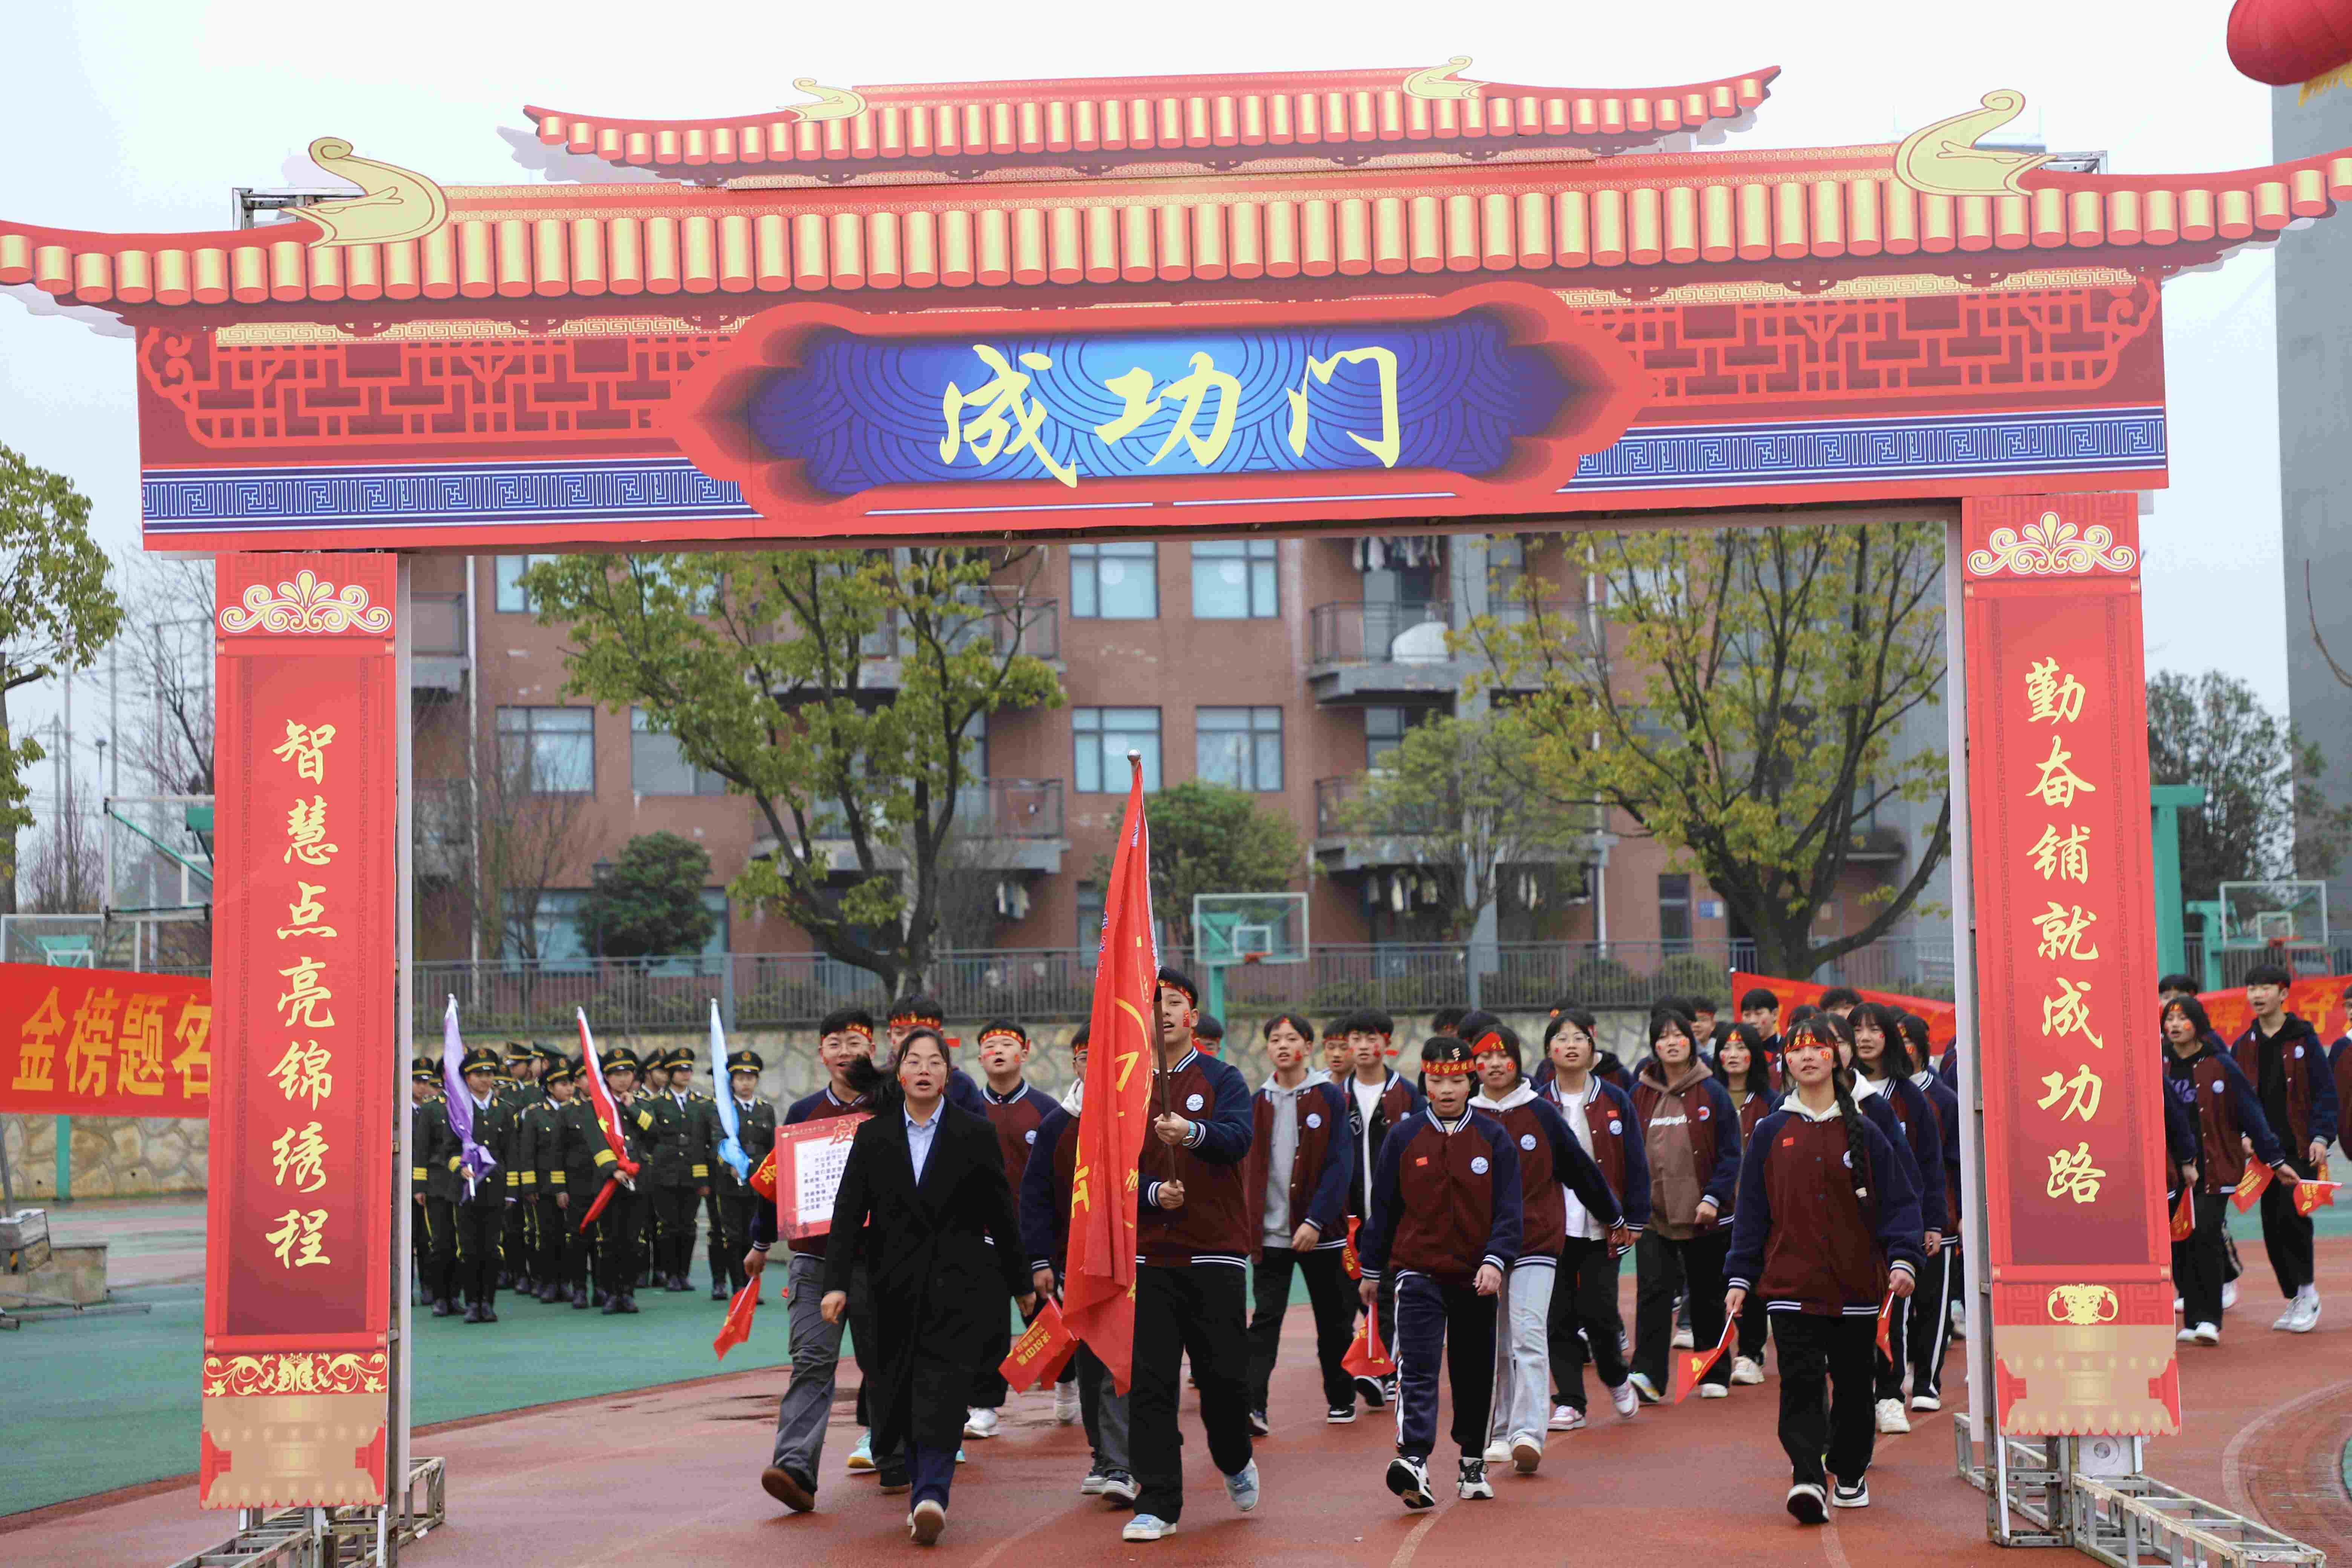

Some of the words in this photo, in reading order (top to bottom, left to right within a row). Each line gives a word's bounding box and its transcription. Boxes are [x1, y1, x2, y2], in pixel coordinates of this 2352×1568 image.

[939, 344, 1400, 488] 成功门
[12, 986, 210, 1099] 金榜题名
[266, 719, 338, 1269] 智慧点亮锦绣程
[2025, 657, 2106, 1204] 勤奋铺就成功路
